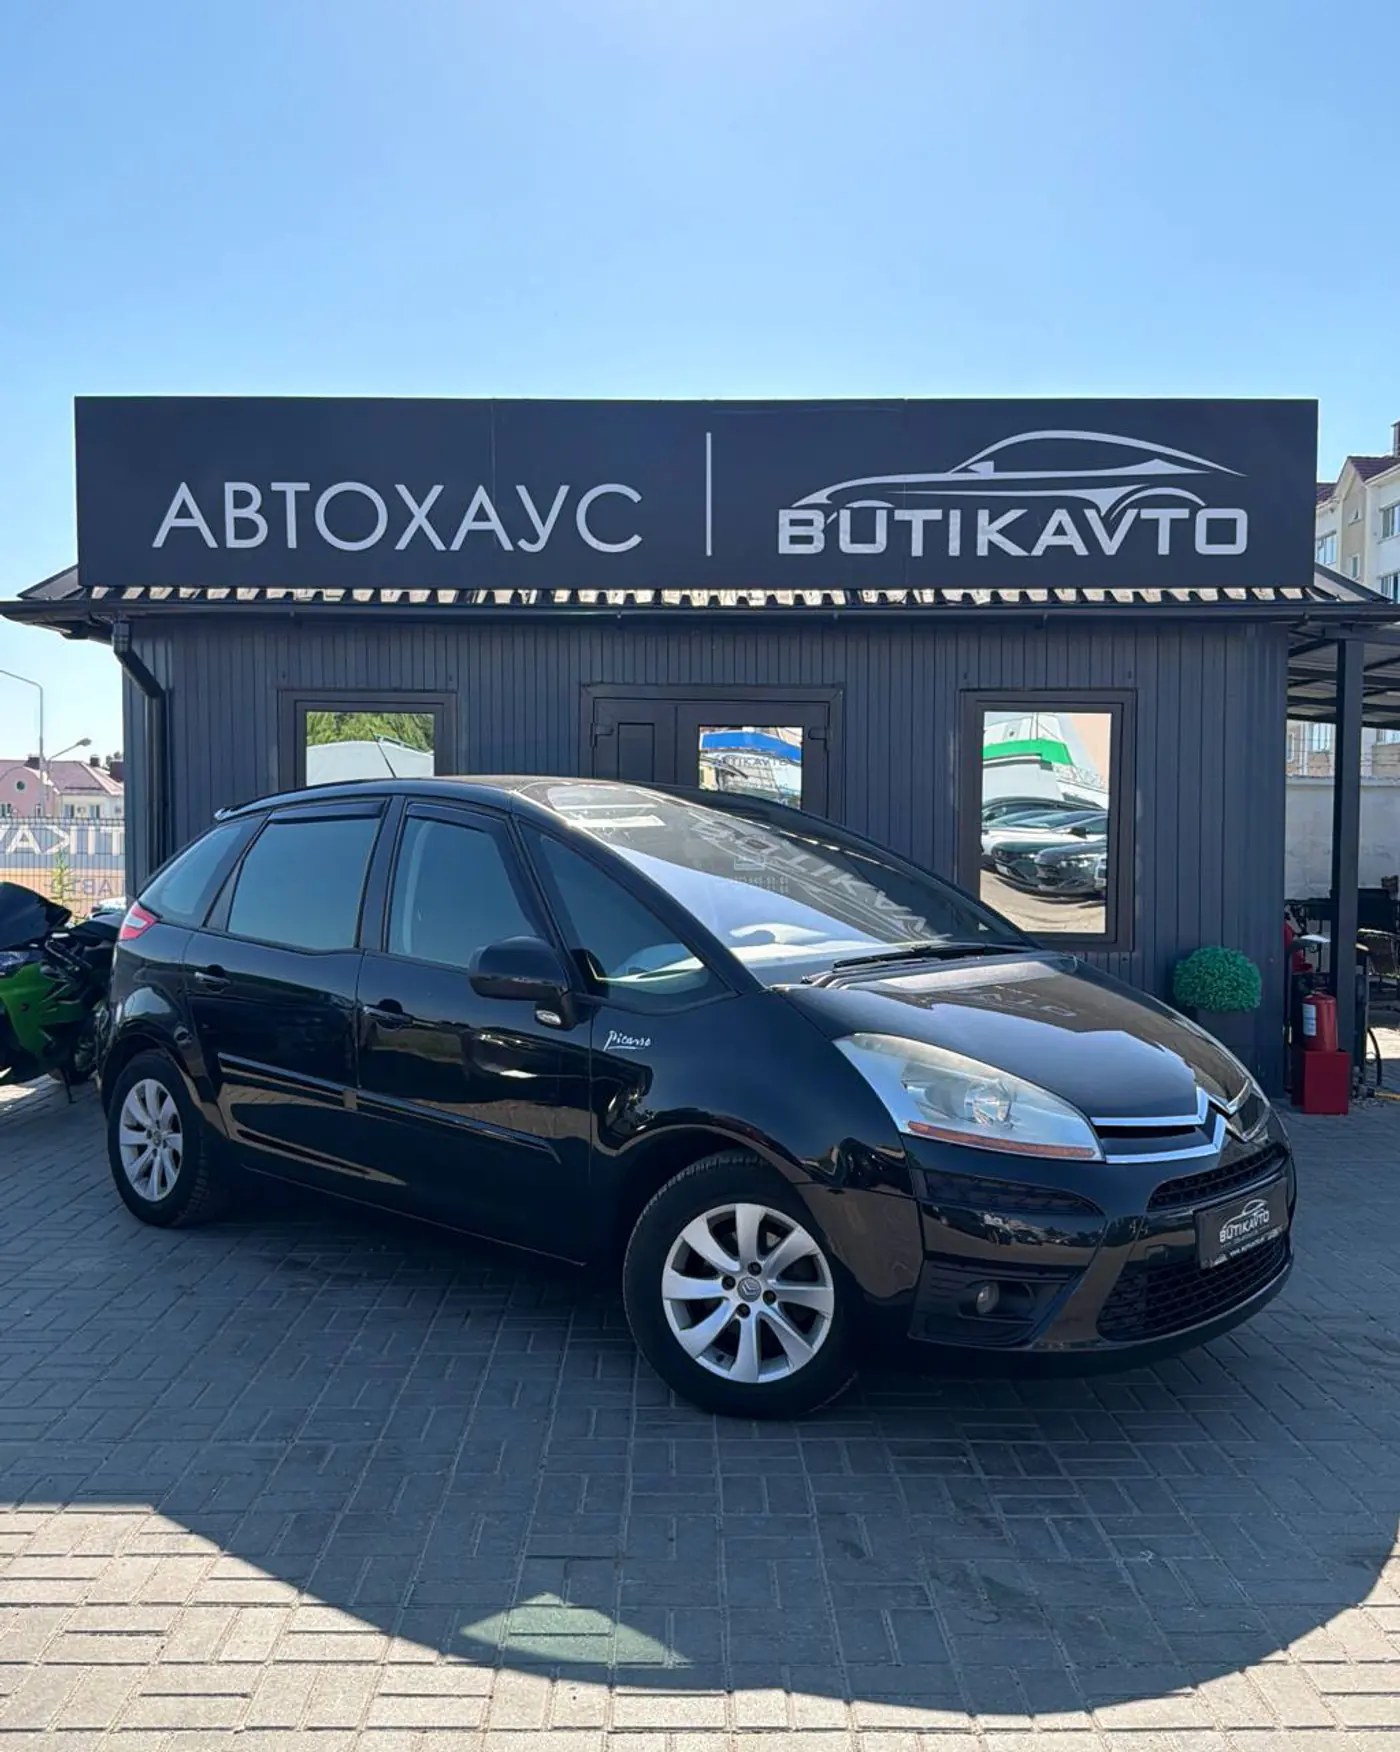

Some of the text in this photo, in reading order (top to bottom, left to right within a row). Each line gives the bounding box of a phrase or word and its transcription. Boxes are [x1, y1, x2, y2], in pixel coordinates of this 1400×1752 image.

[152, 481, 643, 553] АВТОХАУС
[778, 506, 1247, 556] BUTIKAVTO
[1219, 1211, 1270, 1242] BUTIKAVTO
